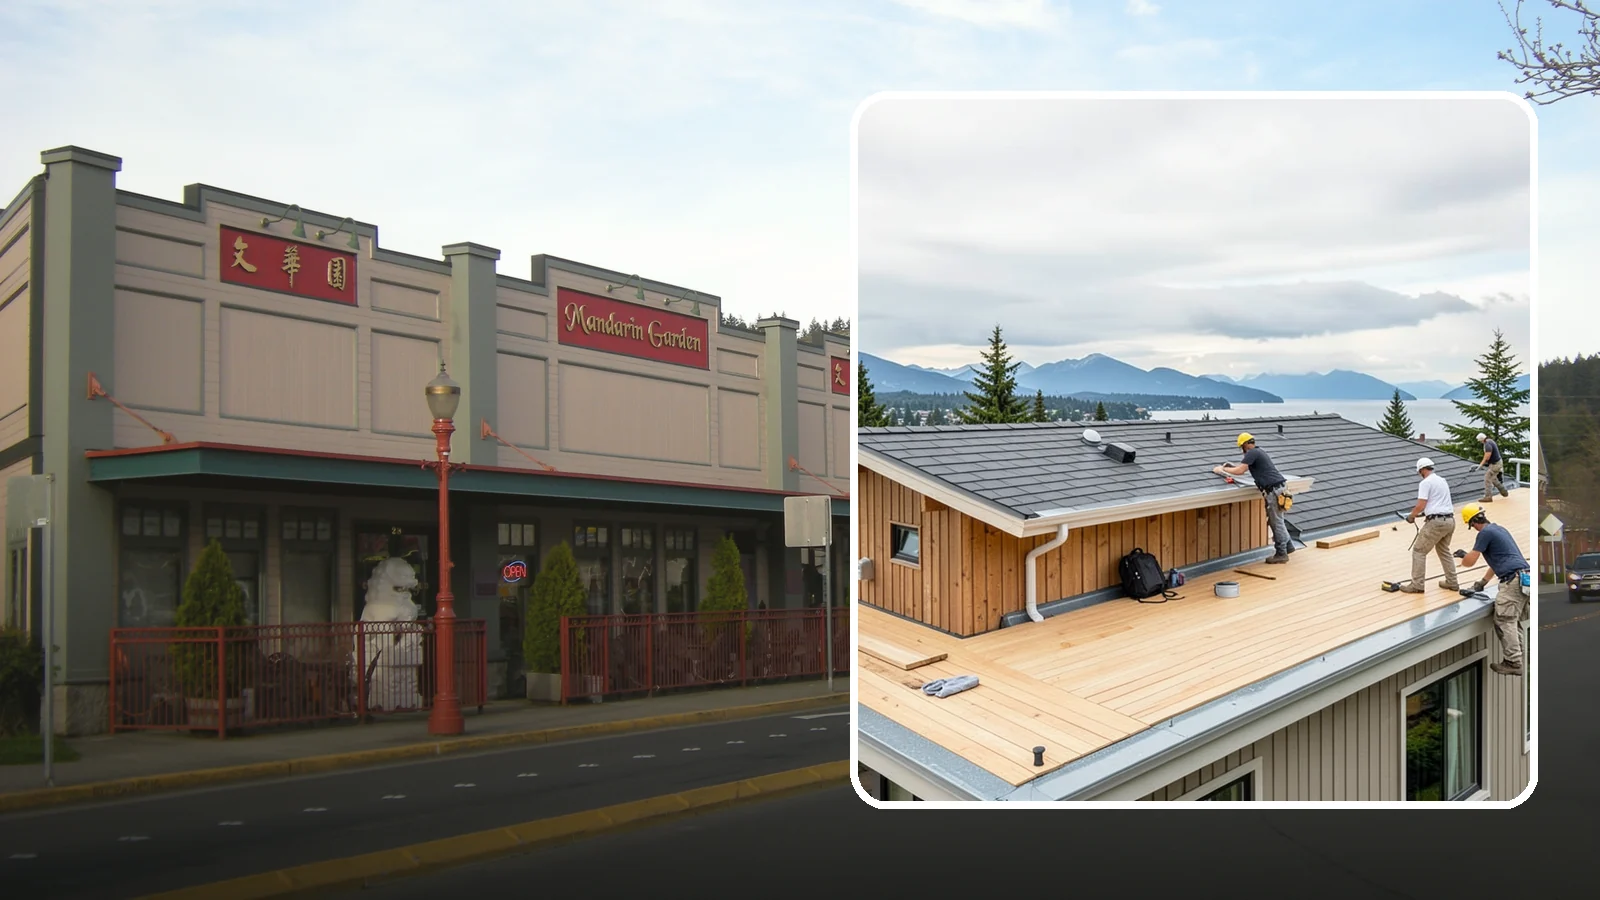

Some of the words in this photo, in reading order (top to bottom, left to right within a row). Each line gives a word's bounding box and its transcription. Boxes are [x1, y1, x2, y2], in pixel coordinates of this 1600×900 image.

[231, 235, 346, 291] 文華園
[564, 302, 644, 341] Mandarin
[648, 320, 701, 352] Garden
[503, 565, 527, 577] OPEN
